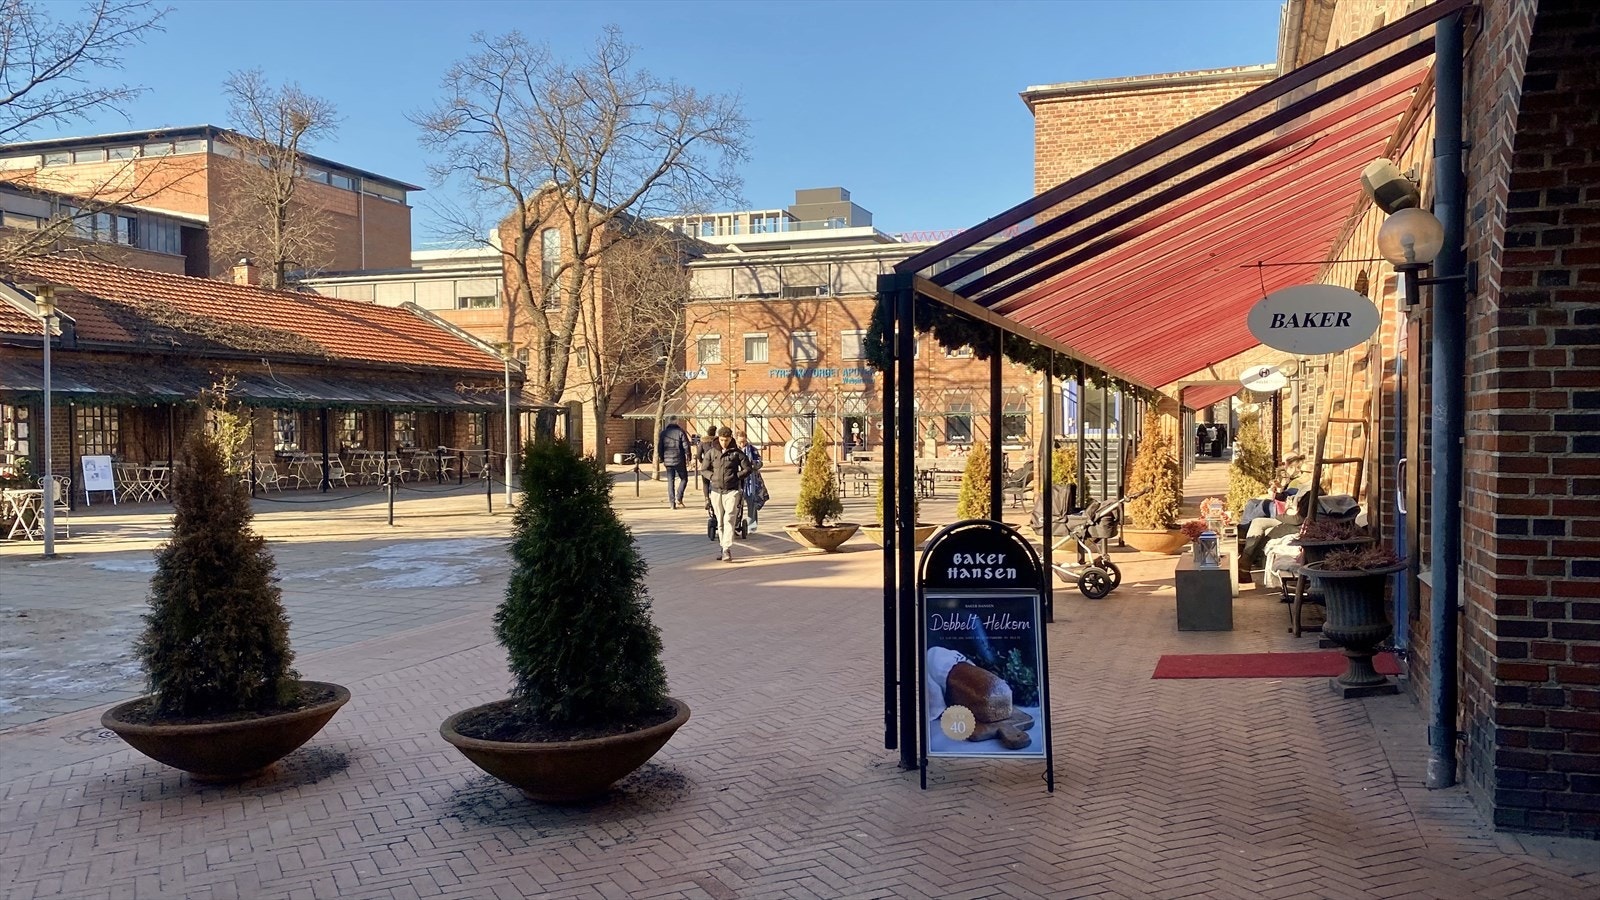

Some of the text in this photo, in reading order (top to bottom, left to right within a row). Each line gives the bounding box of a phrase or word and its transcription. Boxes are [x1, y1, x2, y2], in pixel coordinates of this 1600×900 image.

[1269, 311, 1352, 329] BAKER
[930, 613, 1031, 631] Dobbelt Helkorn
[950, 721, 966, 733] 40
